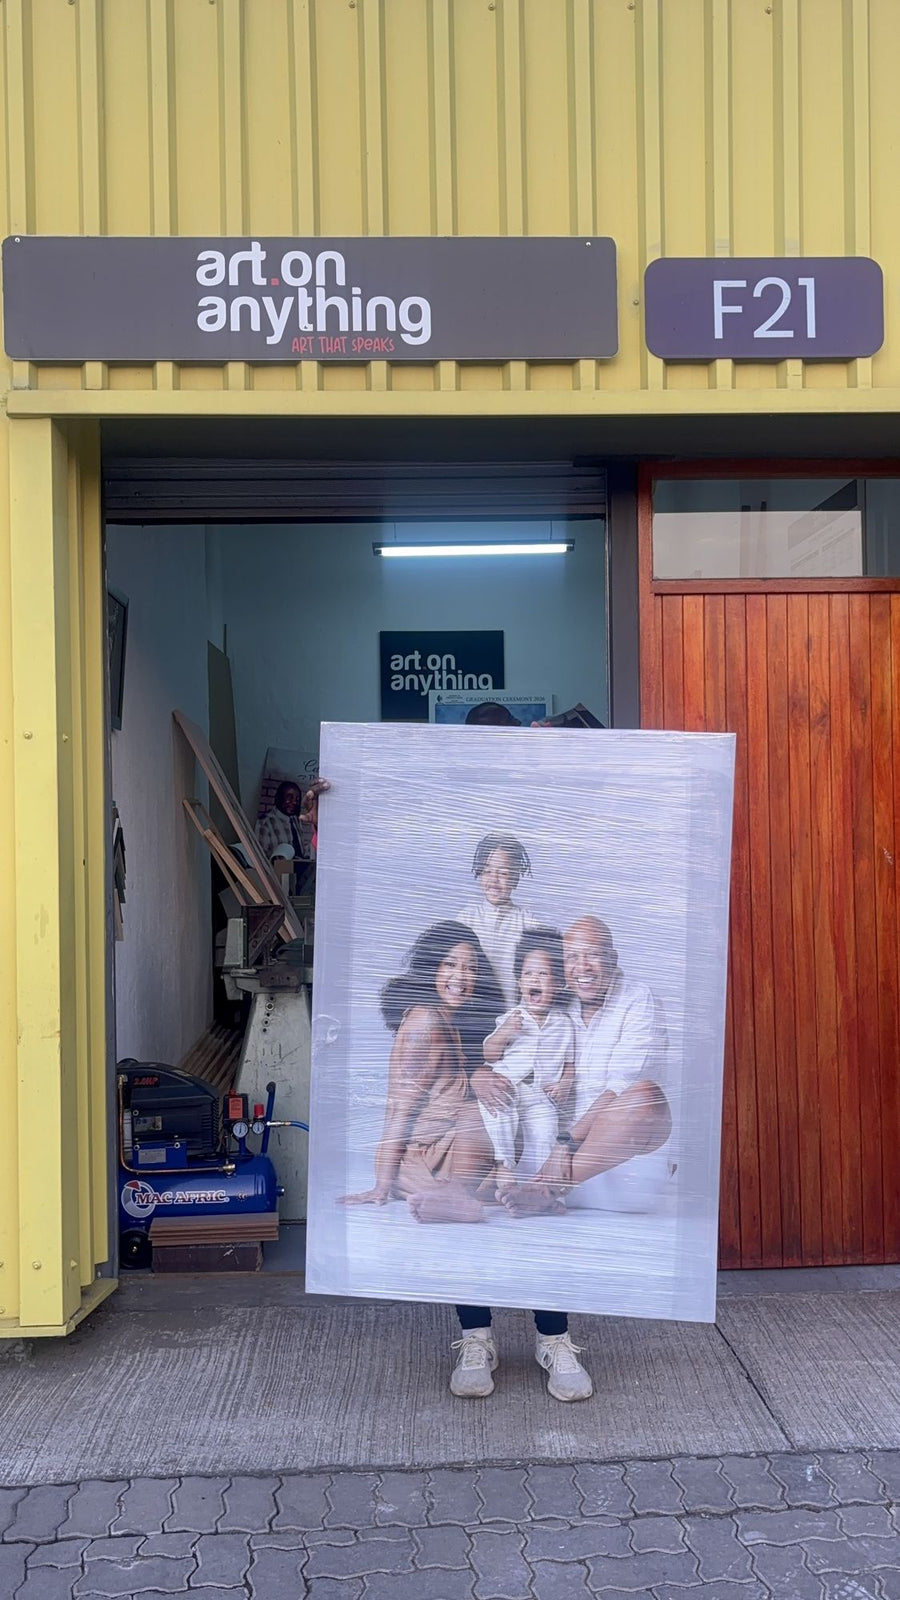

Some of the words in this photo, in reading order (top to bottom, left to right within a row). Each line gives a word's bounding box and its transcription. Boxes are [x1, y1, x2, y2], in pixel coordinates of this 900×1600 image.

[196, 241, 346, 286] art.on
[197, 287, 432, 345] anything
[713, 277, 816, 339] F21
[292, 336, 314, 353] ART
[319, 336, 346, 353] THAT
[390, 650, 455, 671] art.on
[136, 1192, 172, 1204] MAC
